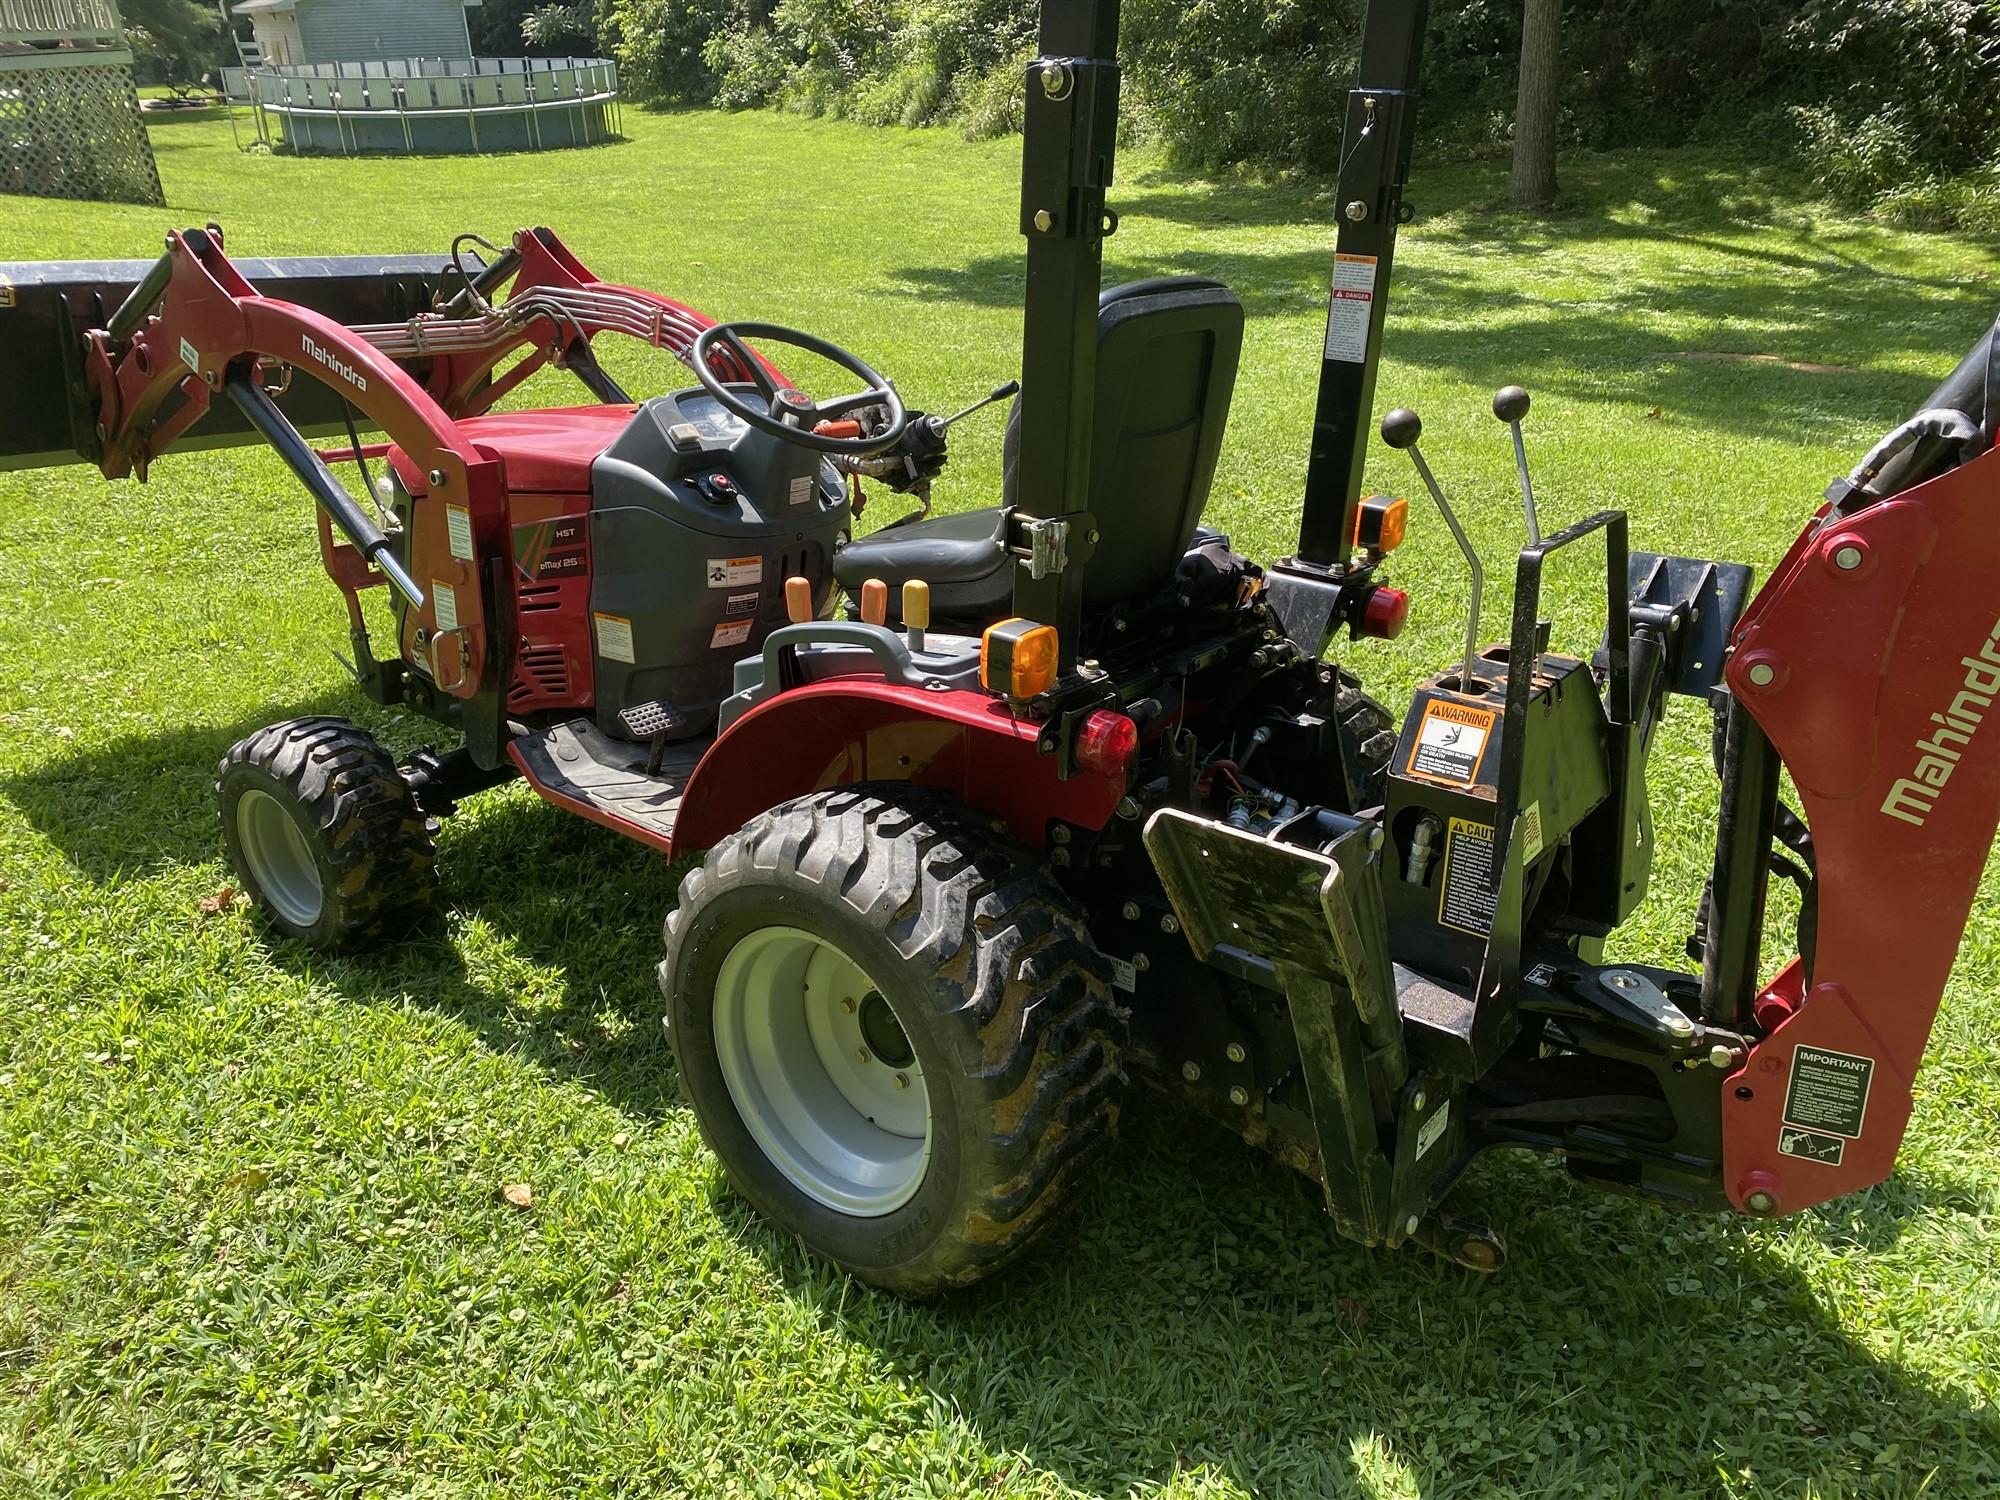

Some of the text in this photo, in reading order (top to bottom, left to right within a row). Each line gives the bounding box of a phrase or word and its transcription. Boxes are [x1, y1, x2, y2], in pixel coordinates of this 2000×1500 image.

[1345, 292, 1369, 300] DANGER
[302, 334, 367, 392] Mahindra
[556, 528, 576, 538] HST
[1442, 706, 1490, 727] WARNING
[1800, 1052, 1868, 1072] IMPORTANT
